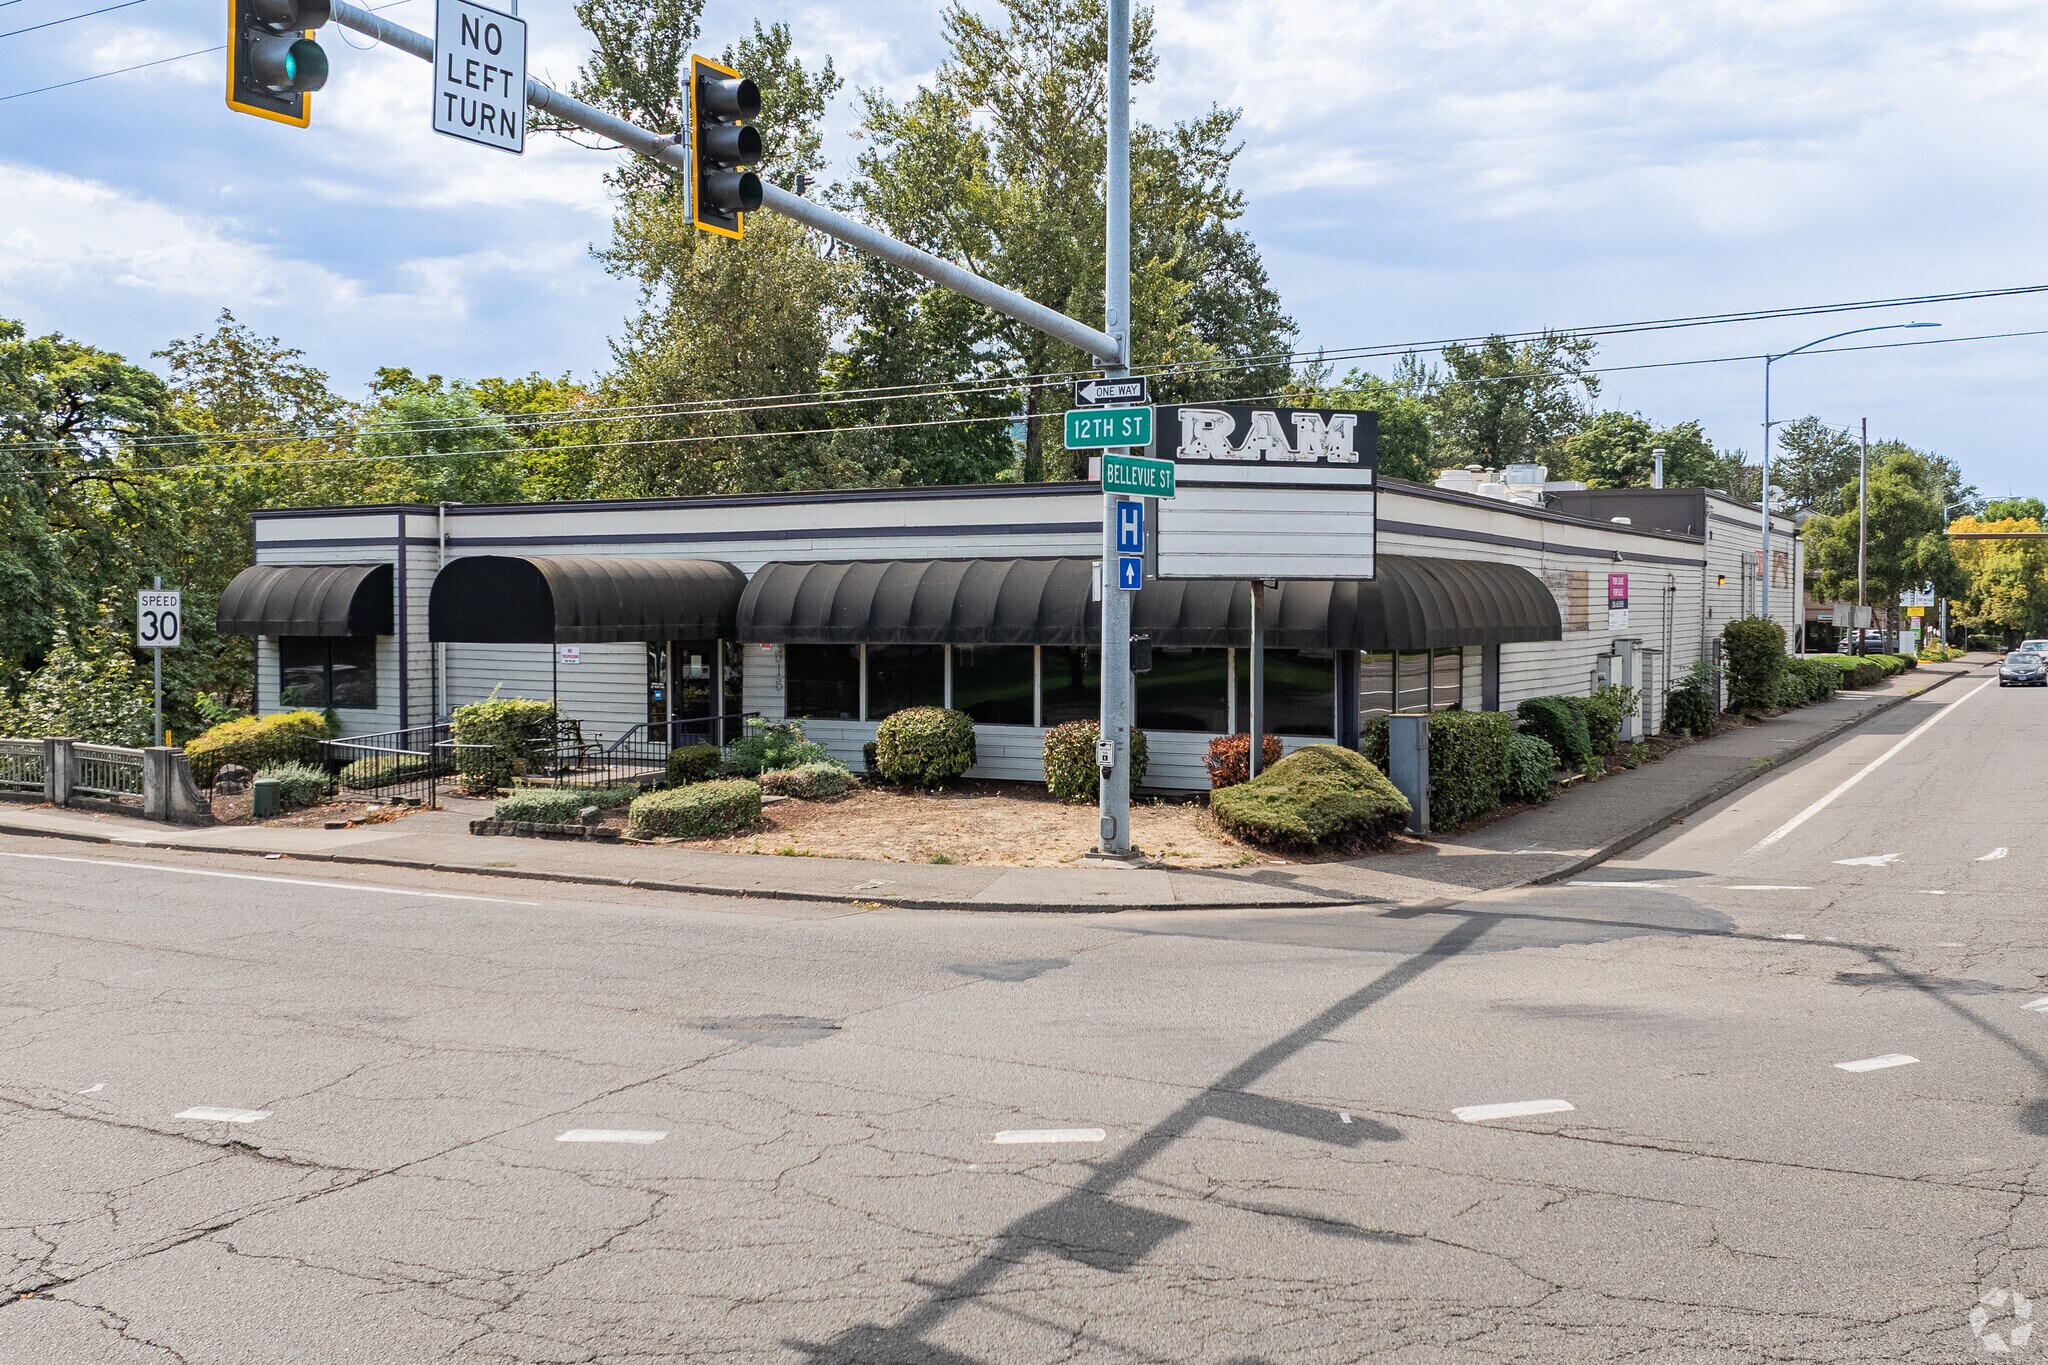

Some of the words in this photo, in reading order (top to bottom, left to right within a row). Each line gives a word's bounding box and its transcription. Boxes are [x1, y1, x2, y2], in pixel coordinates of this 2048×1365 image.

[461, 13, 502, 55] NO
[448, 53, 513, 98] LEFT
[443, 92, 516, 139] TURN
[1096, 386, 1115, 397] ONE
[1118, 385, 1138, 395] WAY
[1075, 418, 1113, 439] 12TH
[1122, 417, 1143, 437] ST
[1177, 408, 1359, 463] RAM
[1107, 464, 1156, 487] BELLEVUE
[1160, 469, 1171, 488] ST
[1122, 508, 1138, 545] H
[142, 595, 177, 606] SPEED
[141, 610, 178, 641] 30
